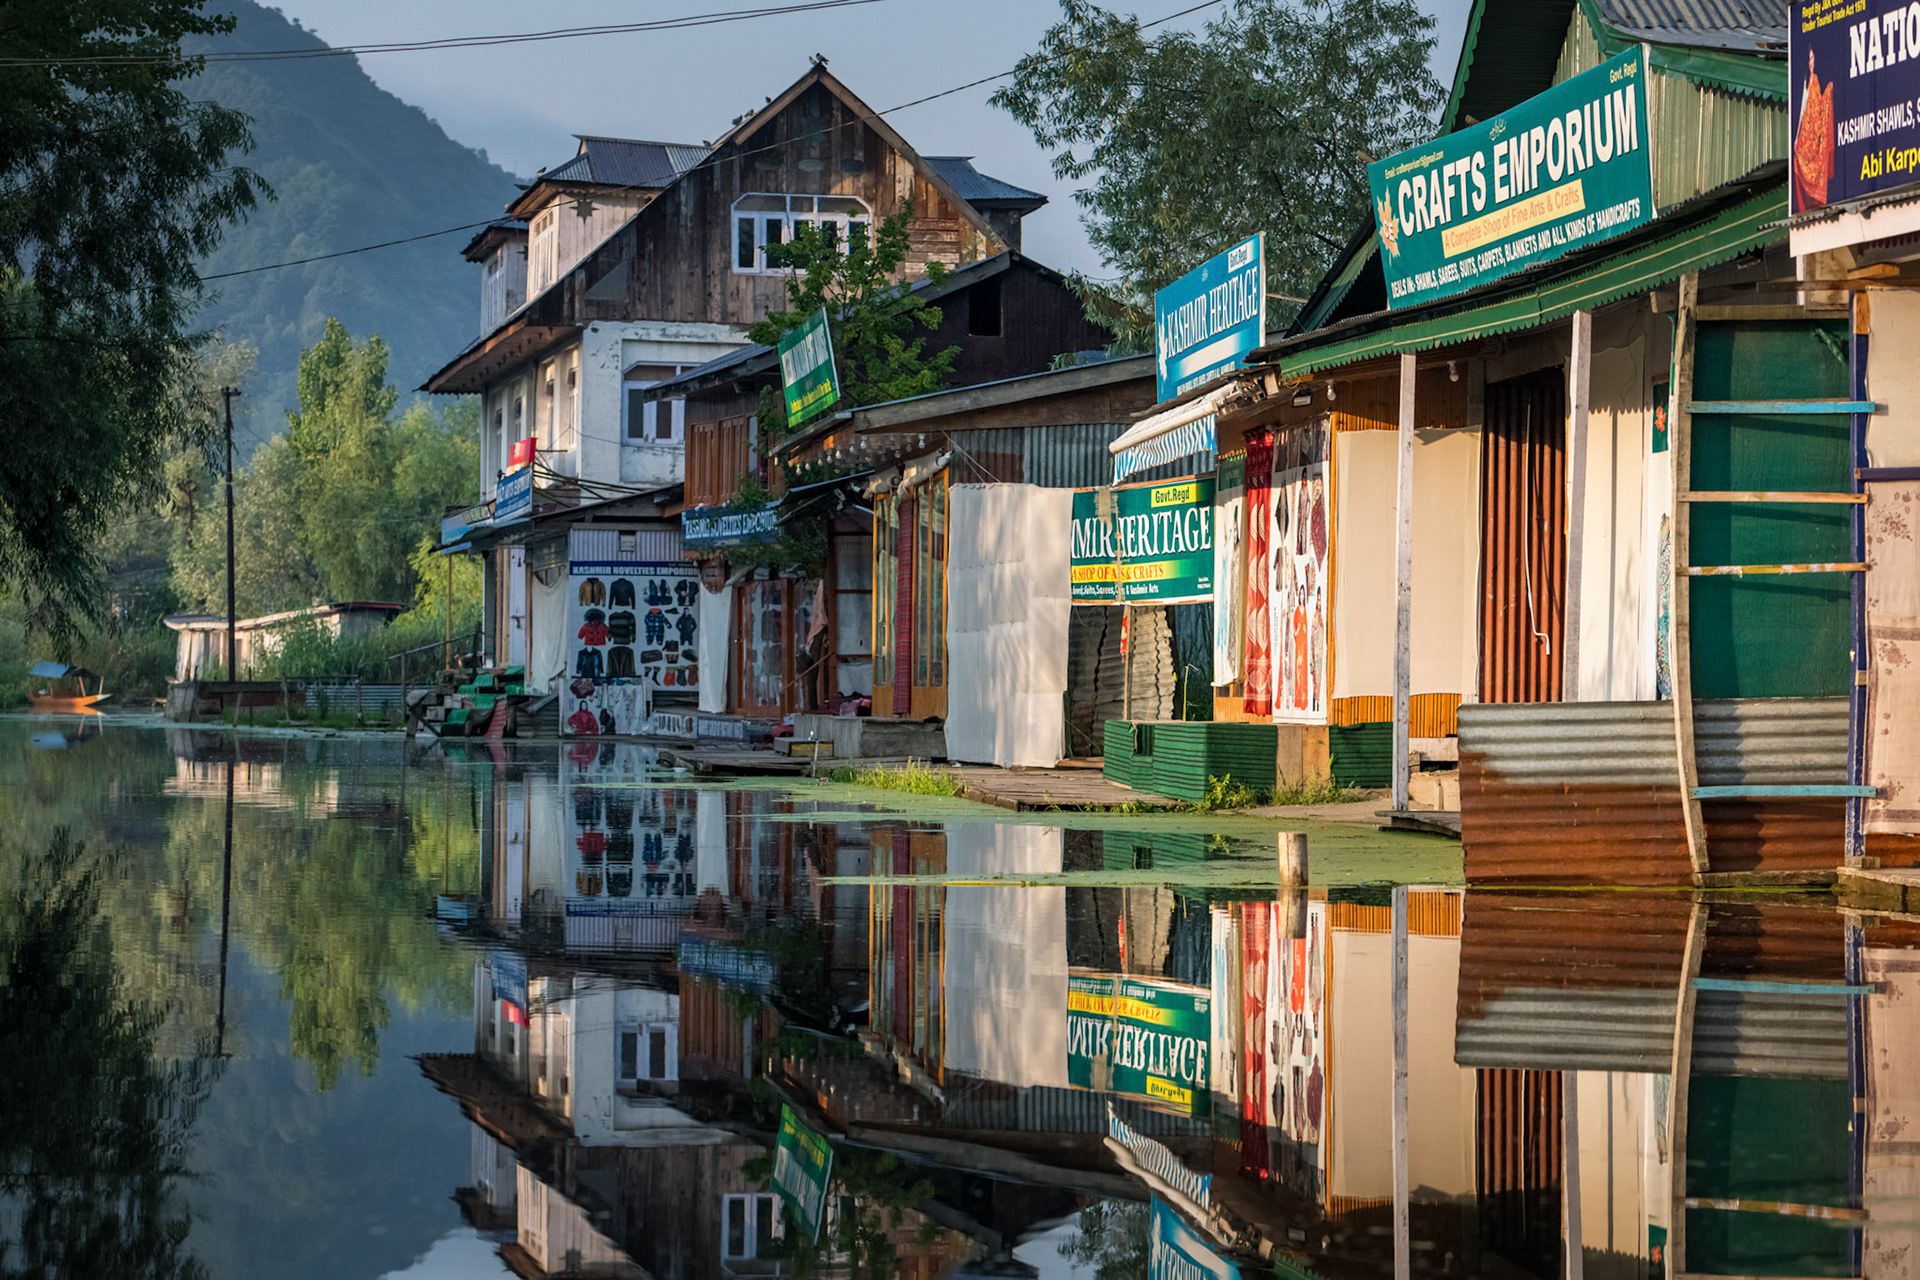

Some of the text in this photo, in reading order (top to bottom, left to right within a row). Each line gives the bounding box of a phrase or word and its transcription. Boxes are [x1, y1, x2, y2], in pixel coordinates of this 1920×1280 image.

[1802, 20, 1816, 33] Under
[1816, 12, 1832, 28] Tourist
[1832, 7, 1845, 21] Trade
[1846, 4, 1854, 16] Act
[1814, 2, 1821, 15] By
[1609, 58, 1637, 83] Govt. Regd
[1837, 112, 1876, 147] KASHMIR
[1876, 100, 1916, 136] SHAWLS,
[1397, 83, 1639, 237] CRAFTS EMPORIUM
[1860, 150, 1883, 181] Abi
[1445, 187, 1580, 250] A Complete Shop of Fine Arts & Crafts
[1504, 234, 1537, 262] BLANKETS
[1537, 227, 1552, 251] AND
[1551, 223, 1567, 247] ALL
[1564, 217, 1586, 242] KINDS
[1586, 213, 1596, 235] OF
[1595, 197, 1641, 231] HANDICRAFTS
[1166, 265, 1259, 359] KASHMIR HERITAGE
[572, 565, 612, 576] KASHMIR
[612, 565, 655, 576] NOVELTIES
[1078, 567, 1096, 581] SHOP
[1097, 566, 1111, 580] OF
[1126, 565, 1132, 580] &
[1133, 563, 1164, 580] CRAFTS
